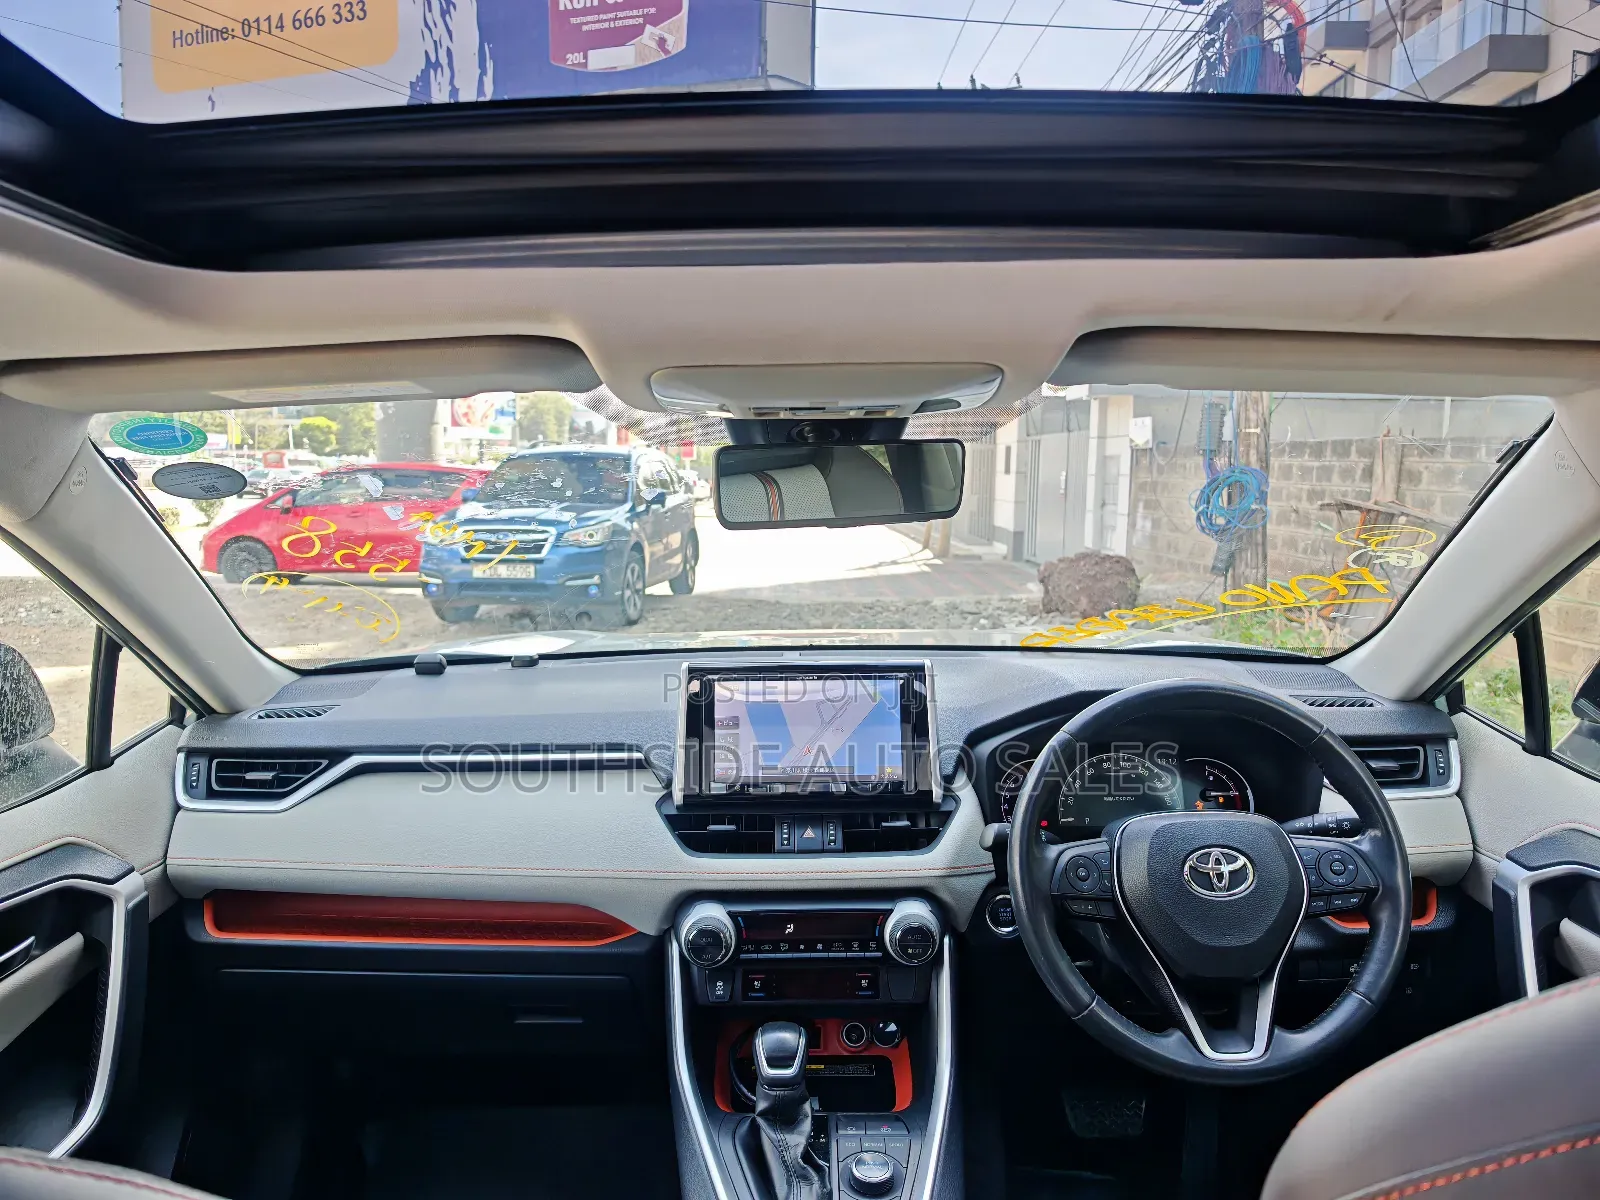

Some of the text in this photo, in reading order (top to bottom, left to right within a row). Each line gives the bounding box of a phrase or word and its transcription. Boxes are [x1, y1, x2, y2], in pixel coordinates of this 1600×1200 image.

[570, 7, 657, 24] TEXTURED PAINT SUITABLE FOR
[172, 0, 368, 49] Hotline: 0114 666 333
[582, 23, 609, 32] INTERIOR
[615, 18, 644, 27] EXTERIOR
[566, 52, 586, 65] 20L
[1119, 761, 1132, 769] 100
[1138, 766, 1150, 777] 120
[1153, 778, 1164, 790] 140
[1067, 796, 1075, 806] 20
